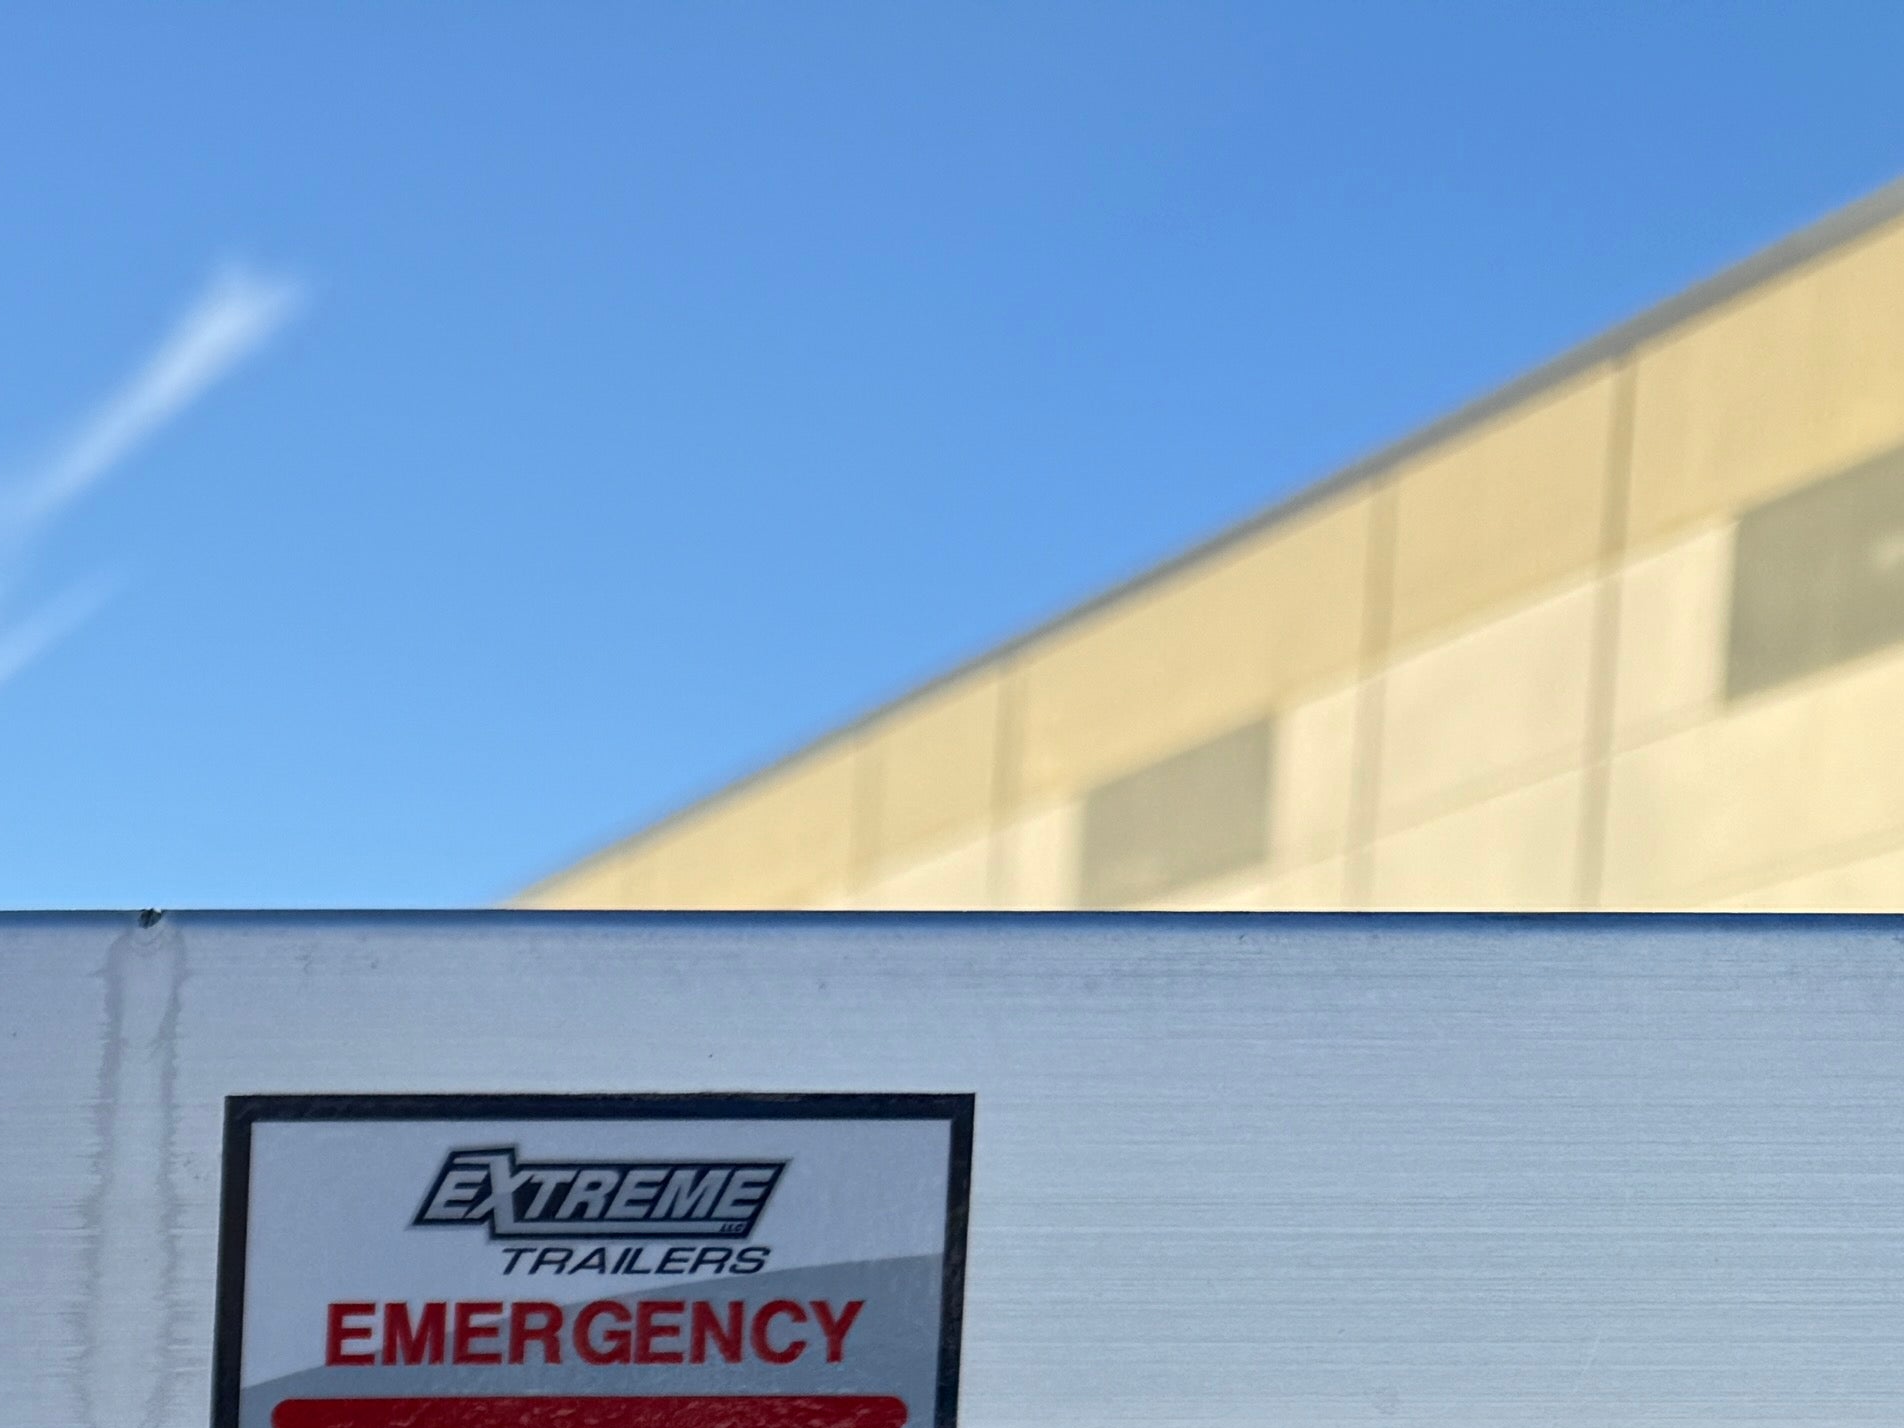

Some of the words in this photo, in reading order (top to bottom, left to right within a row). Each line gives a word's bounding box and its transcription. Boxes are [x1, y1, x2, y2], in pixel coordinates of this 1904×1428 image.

[422, 1154, 779, 1235] EXTREME
[502, 1246, 772, 1276] TRAILERS
[324, 1299, 866, 1367] EMERGENCY
